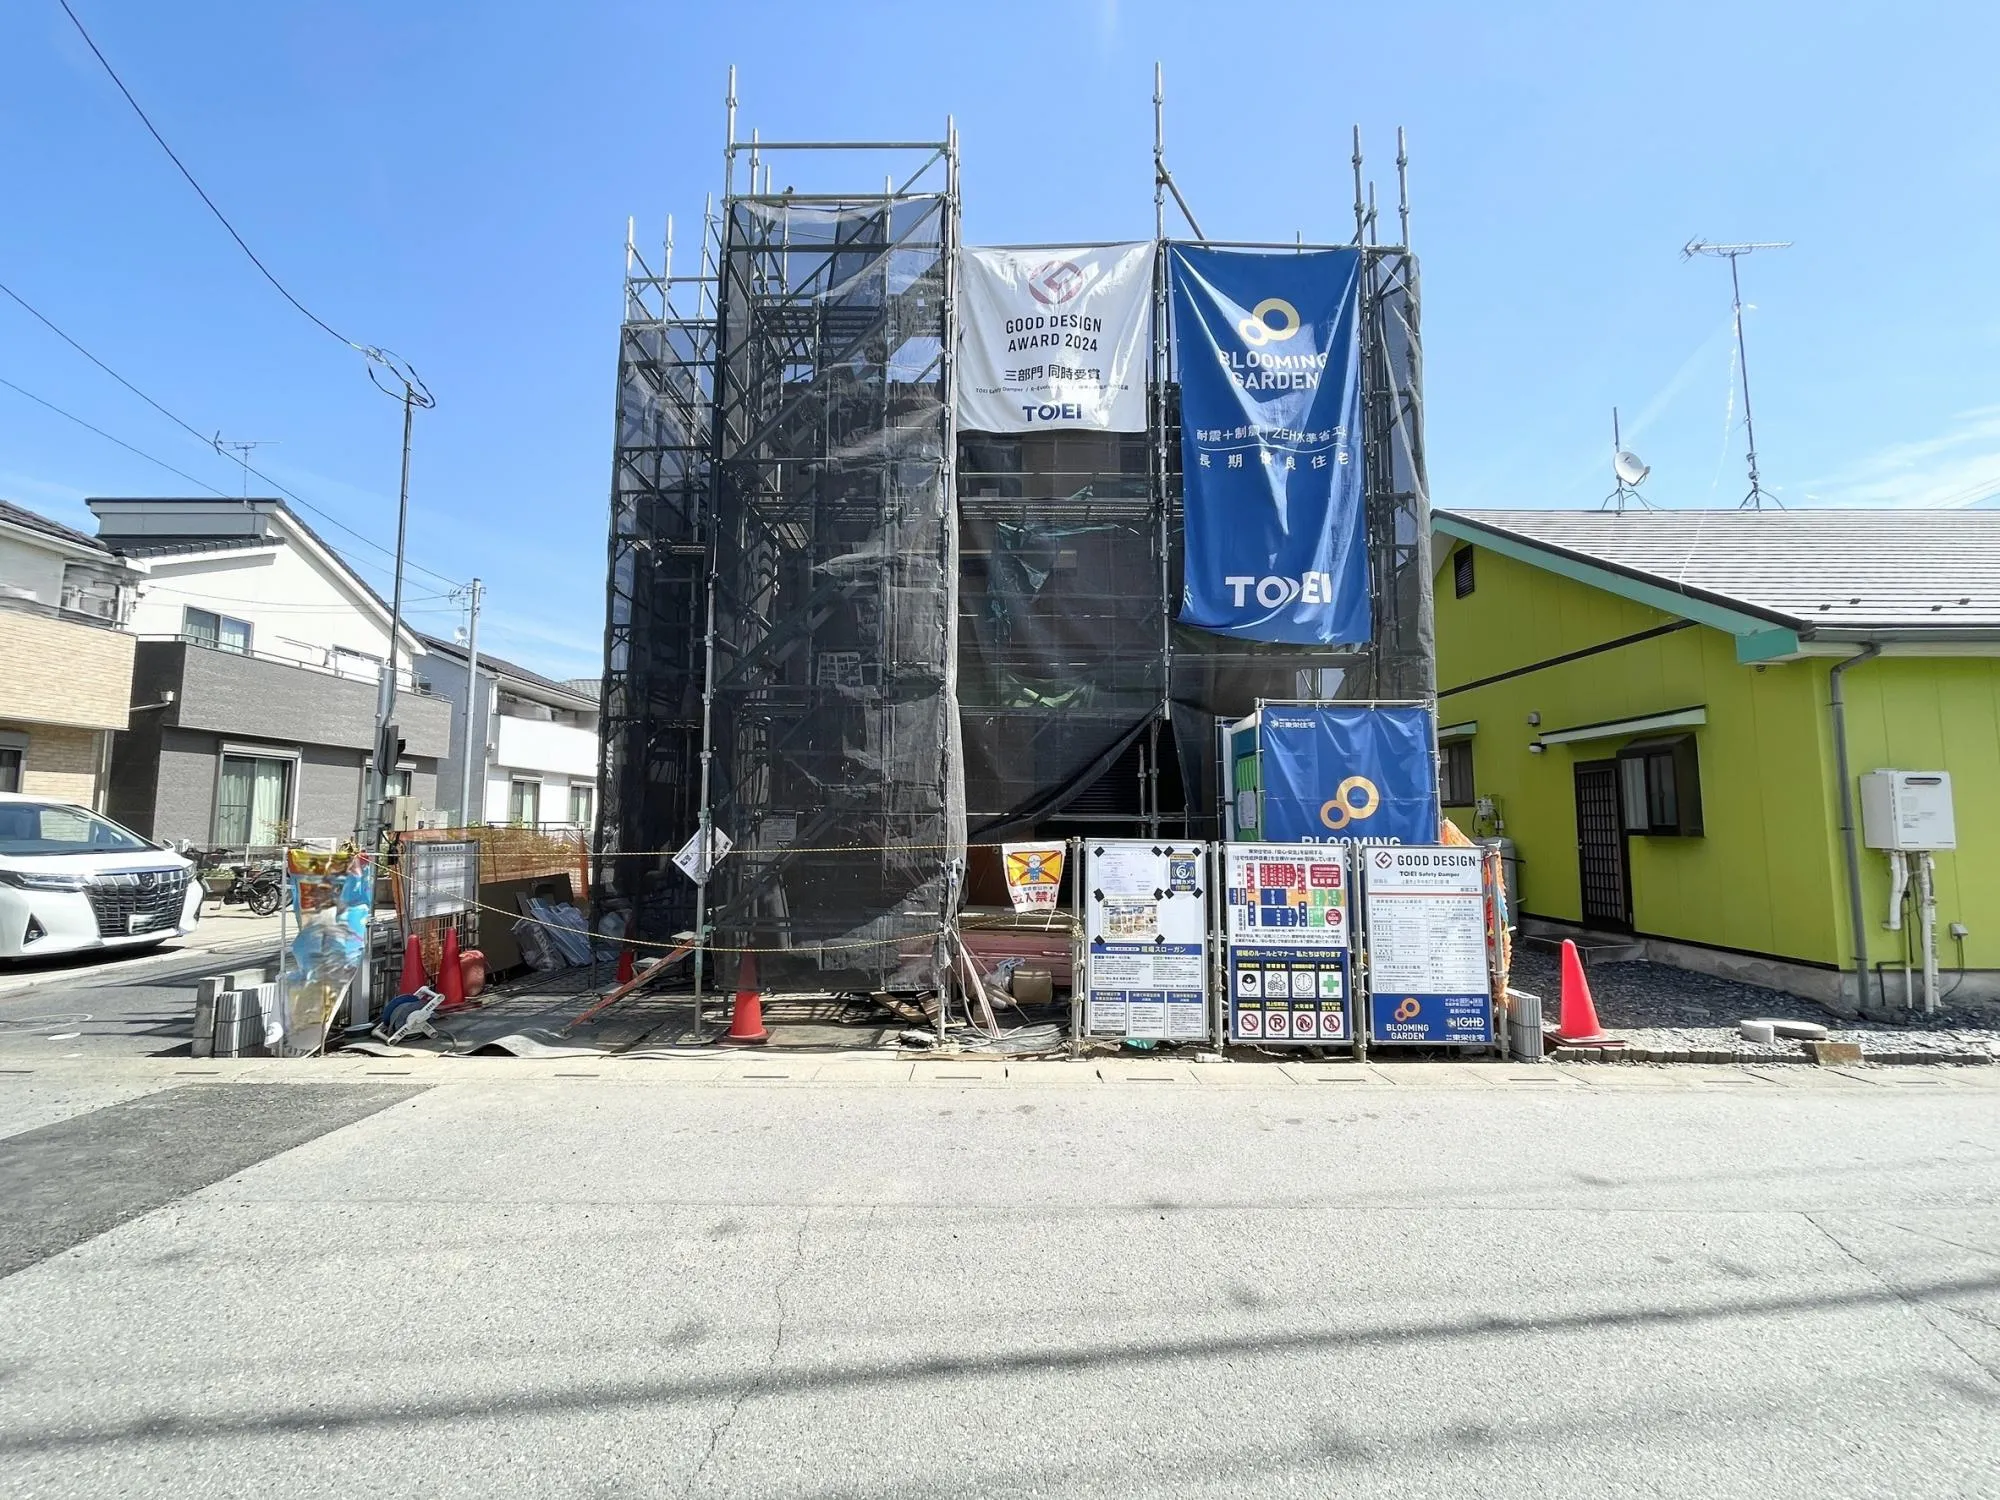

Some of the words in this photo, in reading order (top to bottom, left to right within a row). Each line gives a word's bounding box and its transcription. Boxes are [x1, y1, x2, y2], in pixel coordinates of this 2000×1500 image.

[1006, 316, 1044, 334] GOOD
[1050, 314, 1102, 333] DESIGN
[1008, 333, 1060, 352] AWARD
[1065, 333, 1098, 352] 2024
[1219, 350, 1328, 369] BLOOMING
[1004, 365, 1044, 381] 三部門
[1048, 363, 1101, 381] 同時受賞
[1231, 371, 1320, 390] GARDEN
[1397, 855, 1431, 867] GOOD
[1433, 855, 1476, 867] DESIGN
[1457, 1017, 1484, 1027] IGHD
[1391, 1032, 1424, 1040] GARDEN
